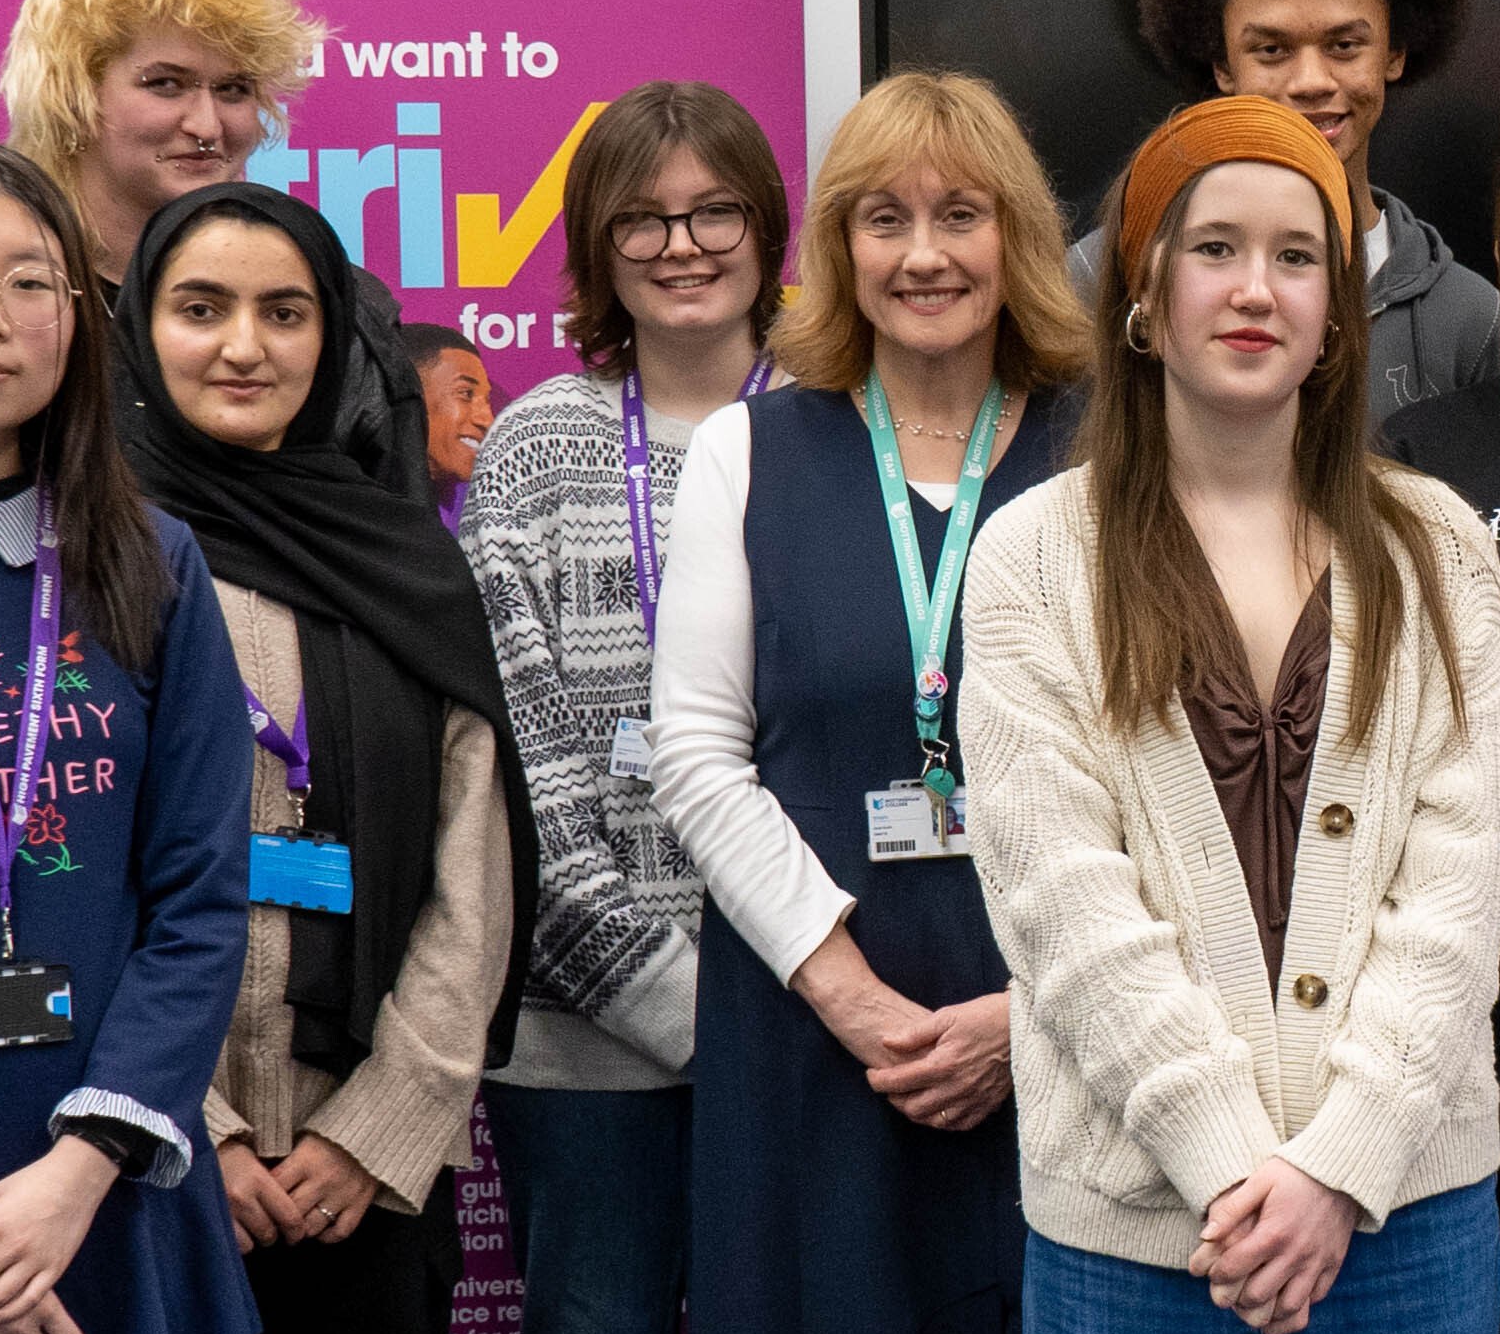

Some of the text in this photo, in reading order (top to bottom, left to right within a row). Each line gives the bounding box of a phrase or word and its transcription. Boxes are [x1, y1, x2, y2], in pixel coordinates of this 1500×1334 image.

[341, 31, 484, 80] want
[501, 31, 559, 79] to
[459, 302, 536, 350] for
[628, 415, 641, 448] STUDENT
[882, 452, 898, 479] STAFF
[636, 500, 654, 573] PAVEMENT SIXTH
[955, 500, 971, 527] STAFF
[40, 574, 53, 619] STUDENT
[928, 594, 948, 653] NOTTINGHAM
[16, 701, 117, 741] HY
[17, 645, 48, 804] HIGH PAVEMENT SIXTH FORM
